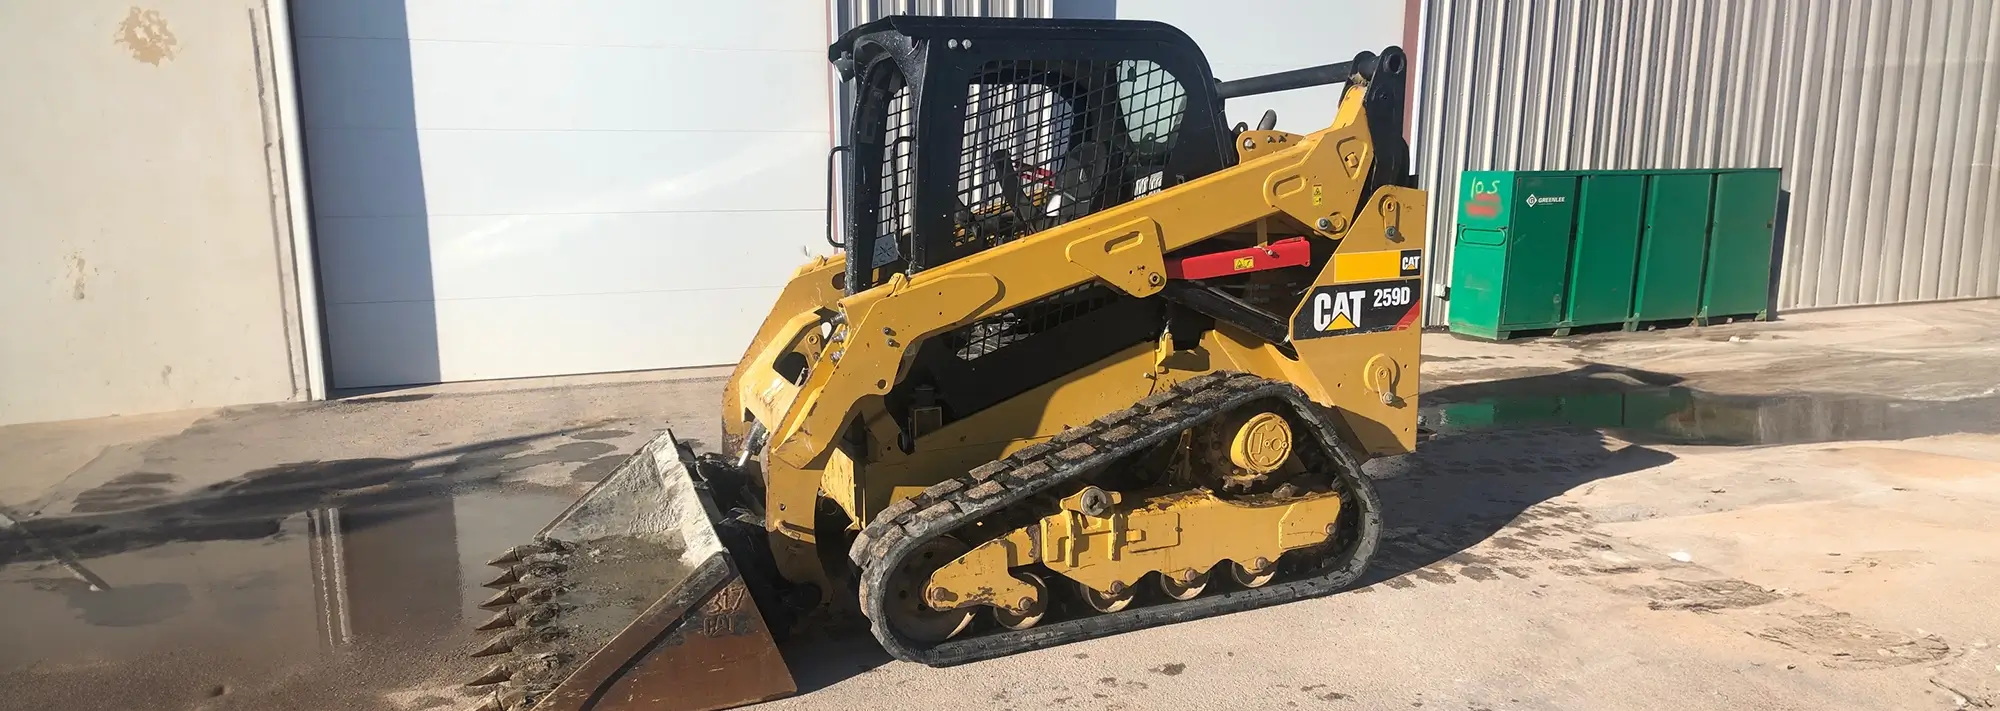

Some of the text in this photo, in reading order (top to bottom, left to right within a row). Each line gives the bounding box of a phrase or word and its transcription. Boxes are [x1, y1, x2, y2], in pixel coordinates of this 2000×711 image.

[1402, 256, 1420, 270] CAT
[1313, 286, 1410, 331] CAT 259D
